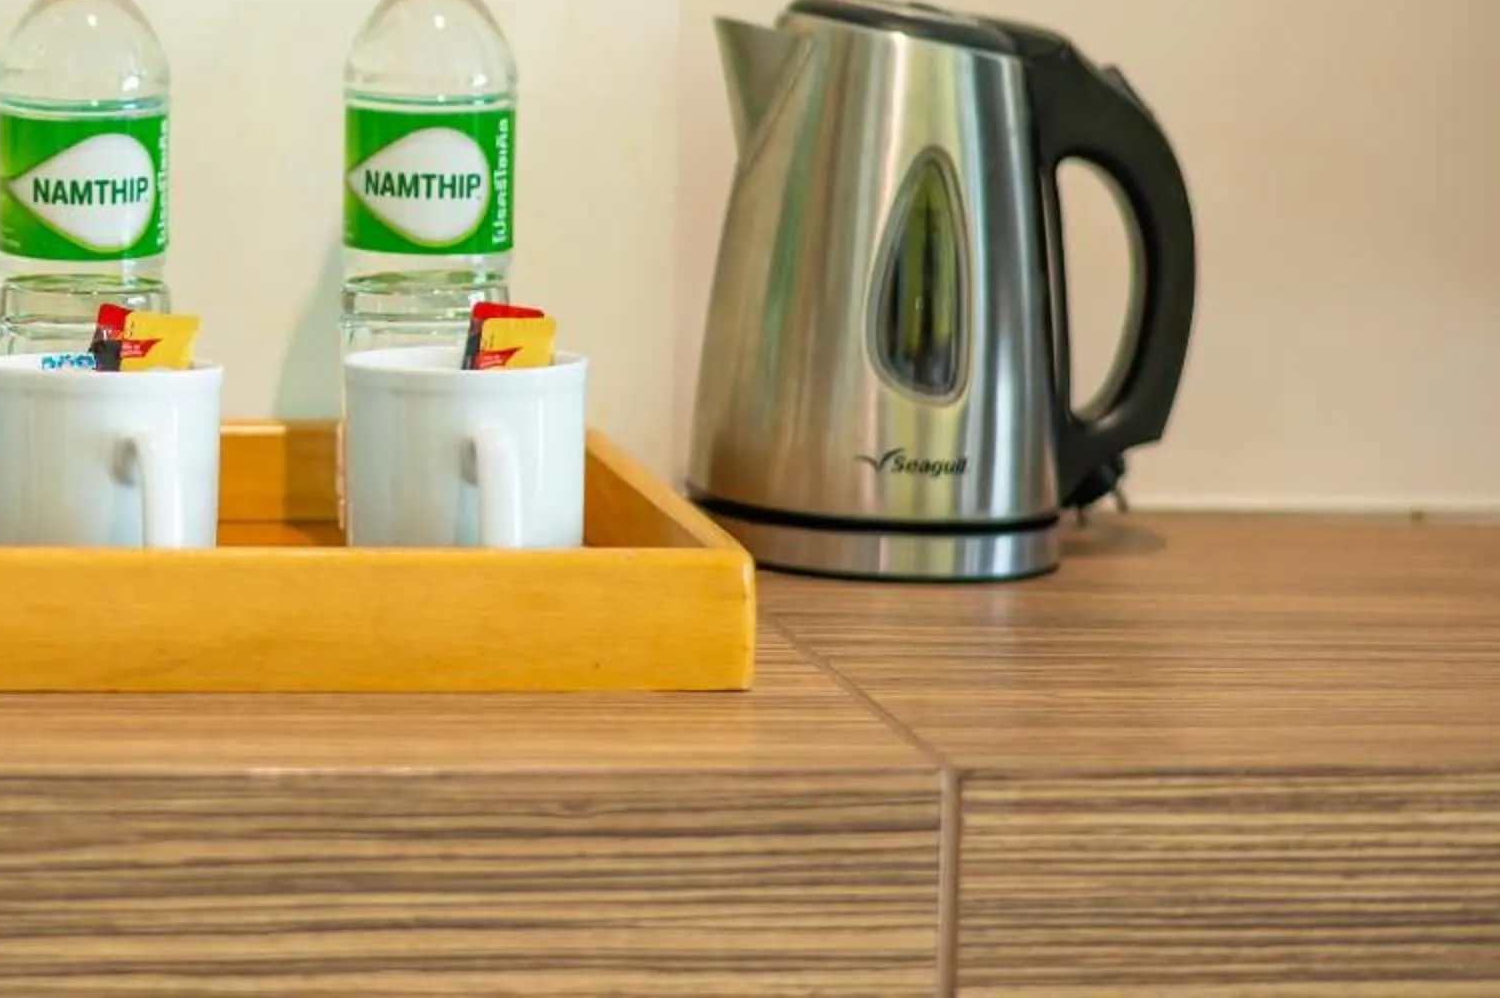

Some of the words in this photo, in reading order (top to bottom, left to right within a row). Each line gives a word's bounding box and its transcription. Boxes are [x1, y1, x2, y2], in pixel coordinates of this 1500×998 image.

[33, 177, 149, 205] NAMTHIP
[365, 170, 482, 200] NAMTHIP
[891, 455, 968, 478] Seagull
